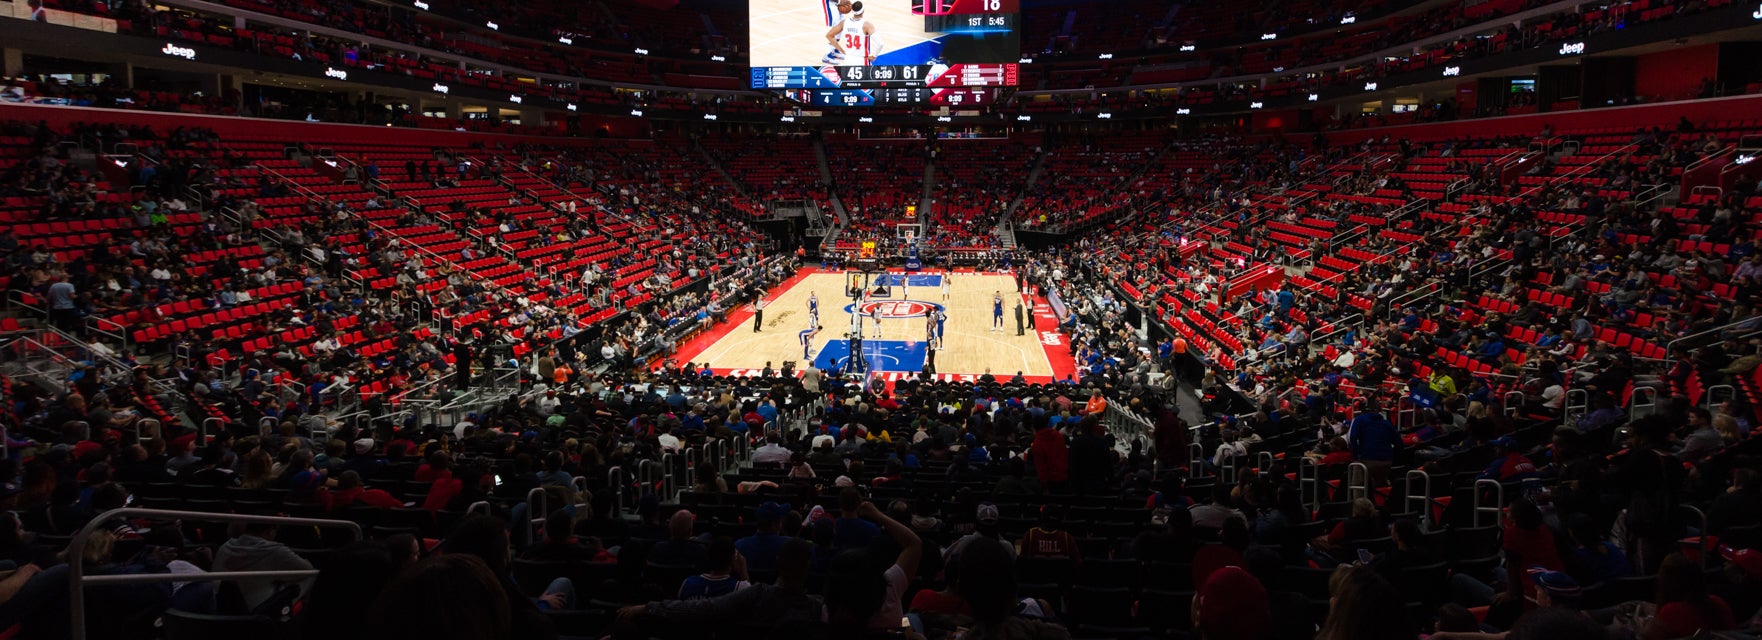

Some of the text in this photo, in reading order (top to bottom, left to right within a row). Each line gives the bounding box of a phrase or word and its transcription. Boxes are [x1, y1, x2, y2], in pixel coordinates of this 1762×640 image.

[414, 0, 428, 10] Jeep
[982, 0, 1000, 10] 18
[487, 21, 498, 30] Jeep
[969, 17, 1004, 26] 1ST 5:45
[845, 34, 862, 49] 34
[163, 43, 195, 59] Jeep
[1560, 42, 1584, 54] Jeep
[326, 68, 346, 80] Jeep
[847, 67, 862, 79] 45
[875, 70, 892, 79] 9:09
[904, 66, 917, 79] 61
[1443, 67, 1459, 76] Jeep
[433, 83, 448, 93] Jeep
[510, 95, 521, 103] Jeep
[860, 248, 873, 258] 24
[1039, 540, 1061, 553] HILL
